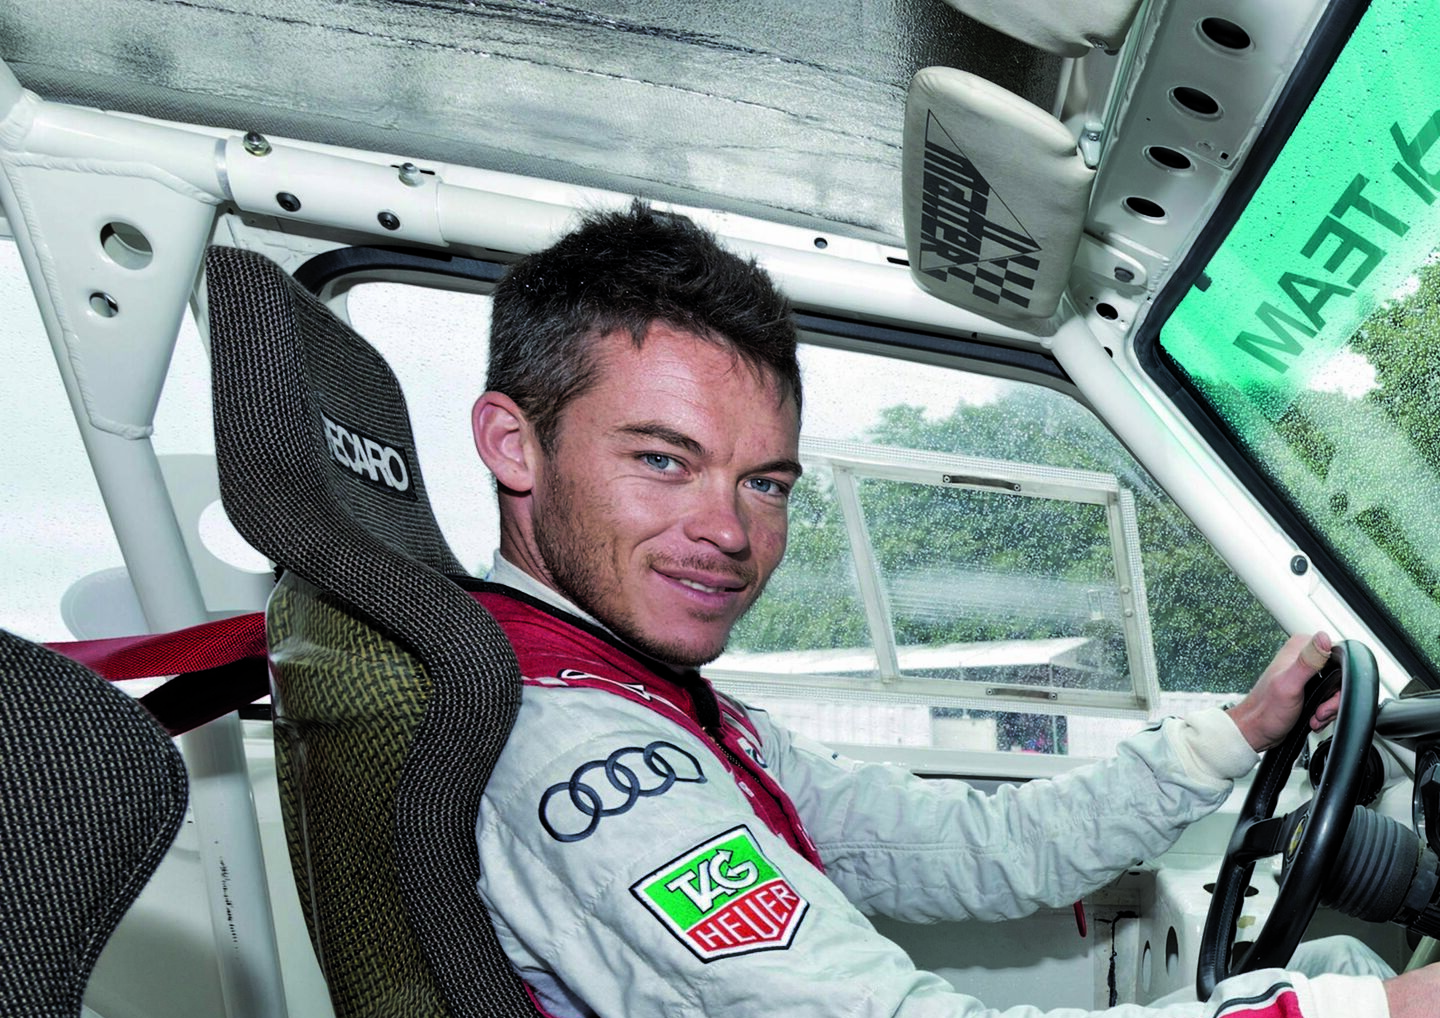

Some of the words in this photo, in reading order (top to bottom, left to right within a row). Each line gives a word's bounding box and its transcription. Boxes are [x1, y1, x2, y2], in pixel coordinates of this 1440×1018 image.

[320, 409, 410, 492] ECARO
[665, 848, 760, 914] TAG
[695, 884, 797, 948] HEUER
